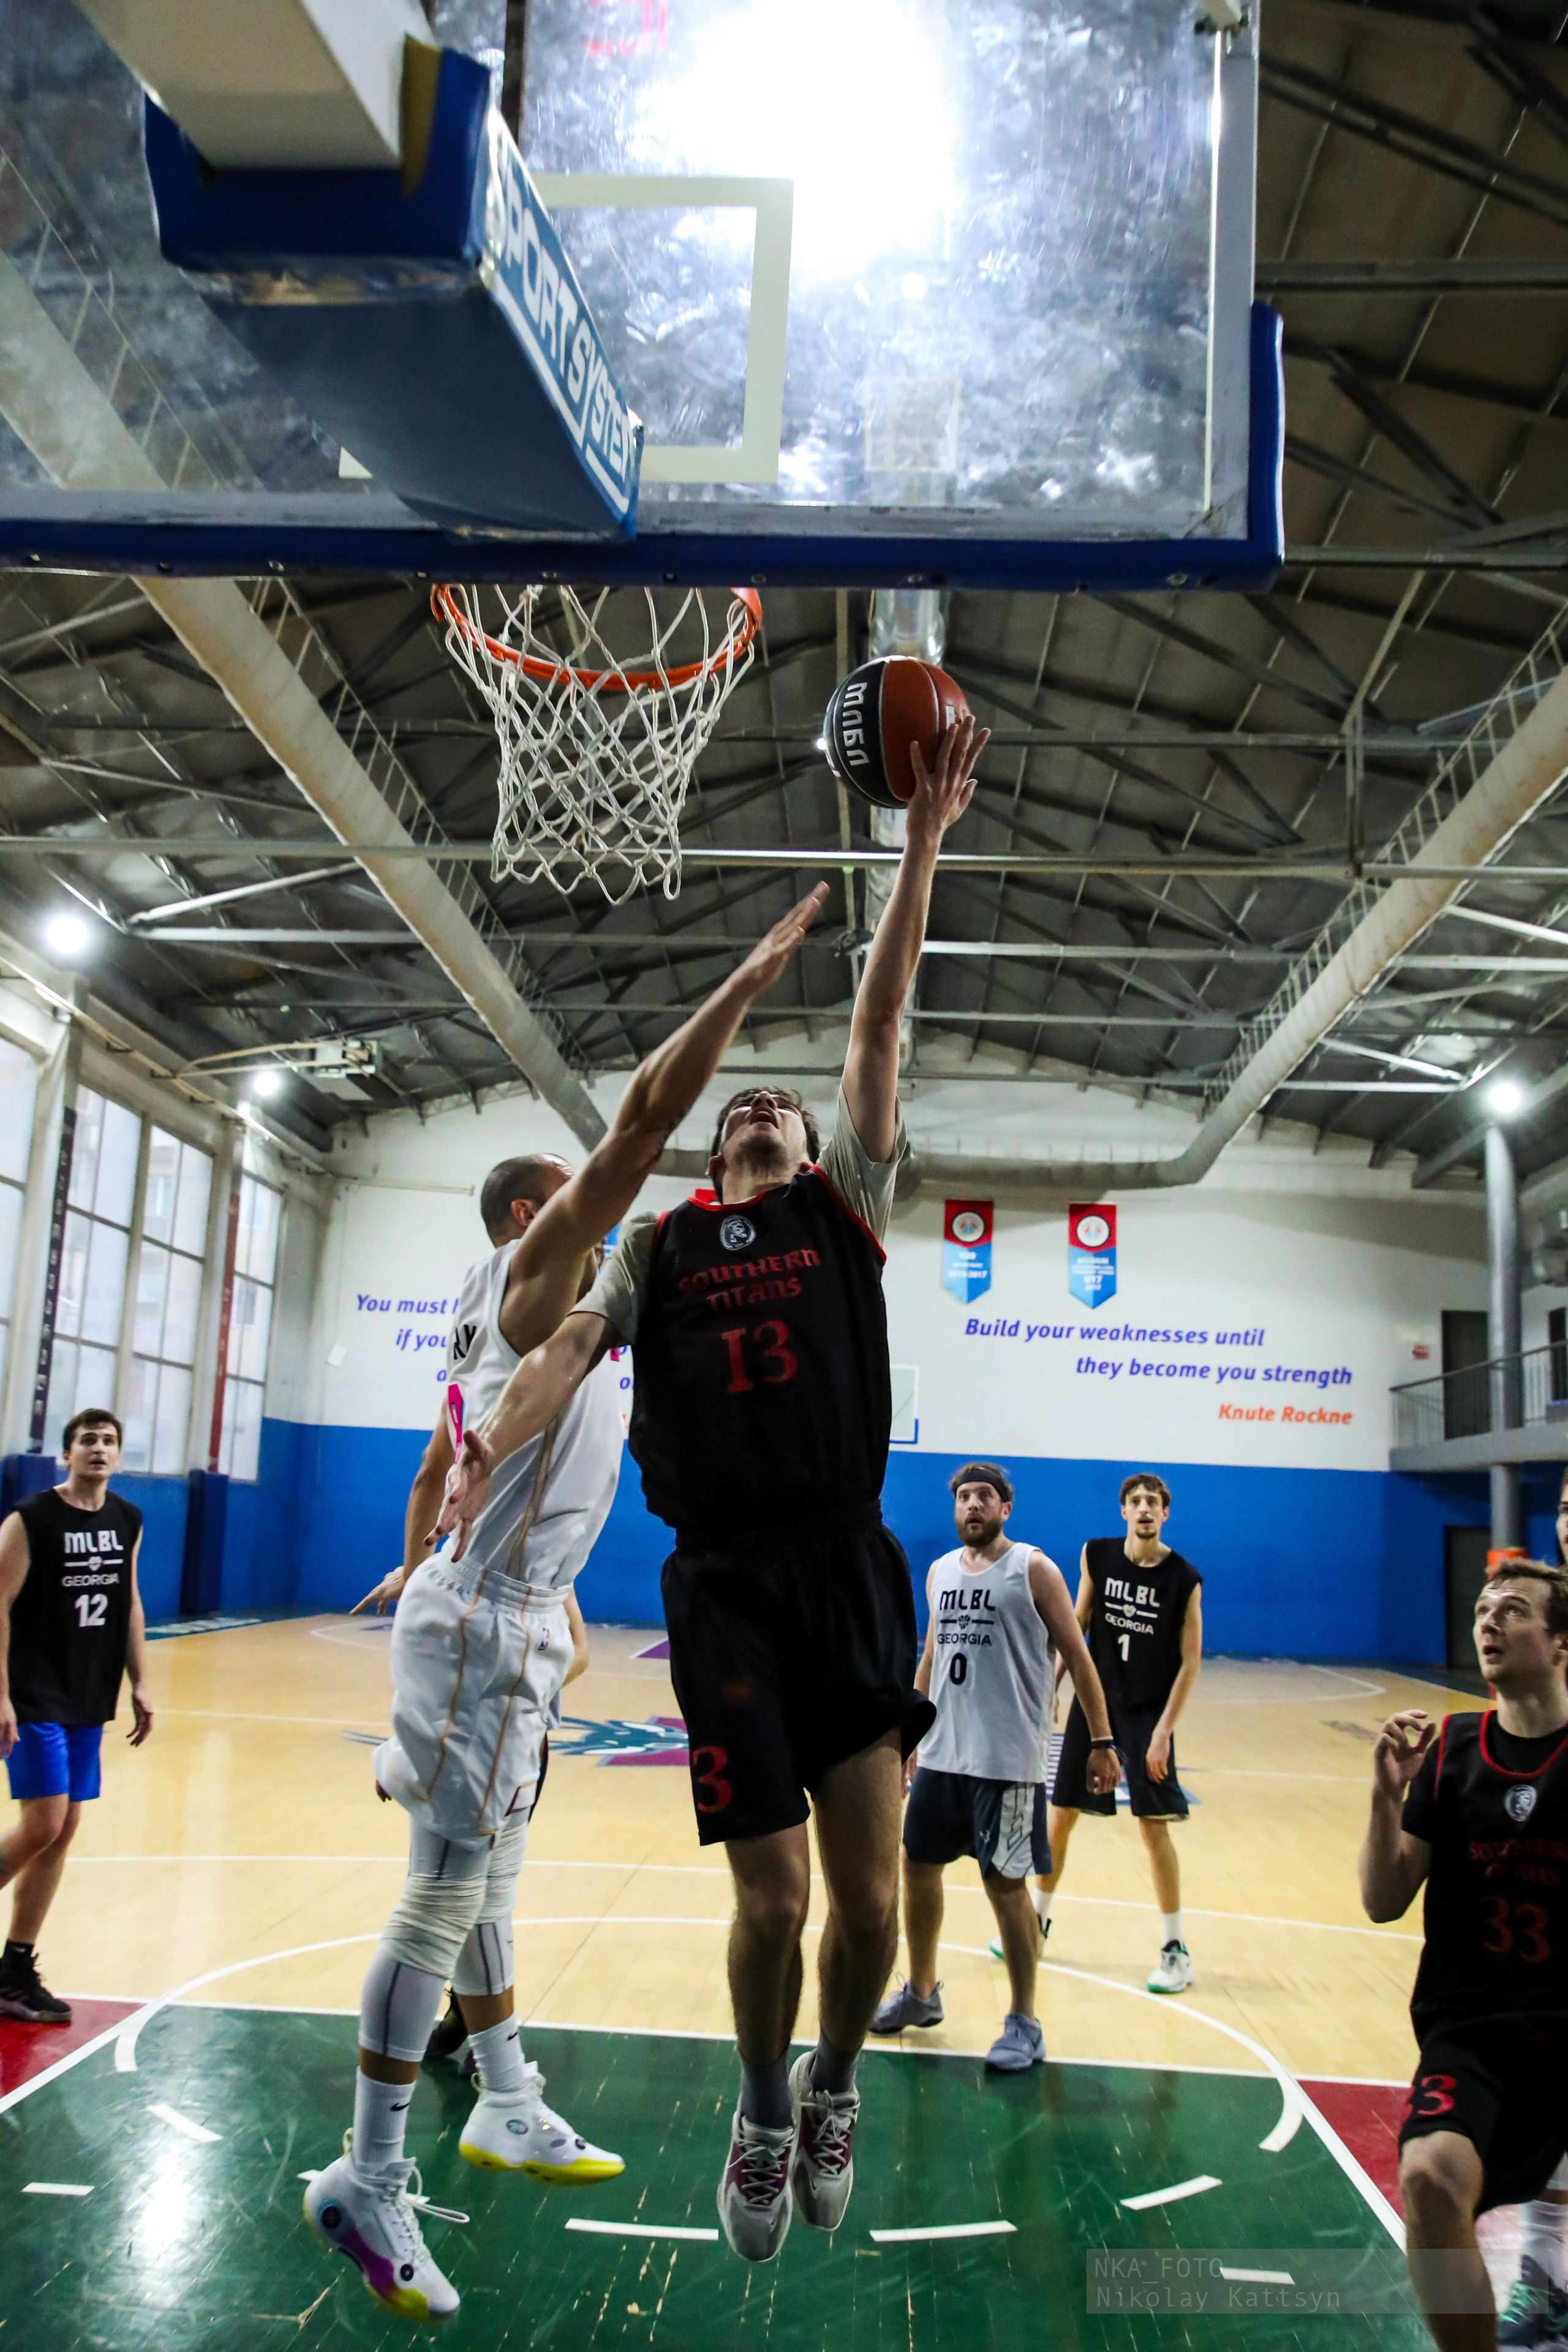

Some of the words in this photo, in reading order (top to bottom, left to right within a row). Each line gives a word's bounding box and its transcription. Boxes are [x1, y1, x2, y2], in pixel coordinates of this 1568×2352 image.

[496, 132, 578, 379] PORT
[357, 1294, 391, 1312] You
[396, 1299, 448, 1314] must
[396, 1329, 412, 1351] if
[965, 1318, 1020, 1337] Build
[1025, 1324, 1074, 1343] your
[1080, 1324, 1208, 1345] weaknesses
[1215, 1329, 1265, 1347] until
[721, 1319, 799, 1393] 13
[1076, 1357, 1123, 1379] they
[1129, 1359, 1211, 1379] become
[1216, 1366, 1256, 1384] you
[1262, 1365, 1353, 1389] strength
[1218, 1404, 1275, 1422] Knute
[1281, 1406, 1353, 1425] Rockne
[64, 1530, 124, 1553] MLBL
[62, 1573, 119, 1587] GEORGA
[1105, 1577, 1160, 1608] MLBL
[75, 1594, 108, 1627] 12
[940, 1589, 996, 1611] MLBL
[1105, 1612, 1155, 1635] GEORGIA
[937, 1633, 992, 1647] GEORGIA
[1118, 1634, 1130, 1662] 1
[949, 1652, 967, 1685] 0
[693, 1746, 732, 1814] 3
[1478, 1893, 1553, 1967] 33
